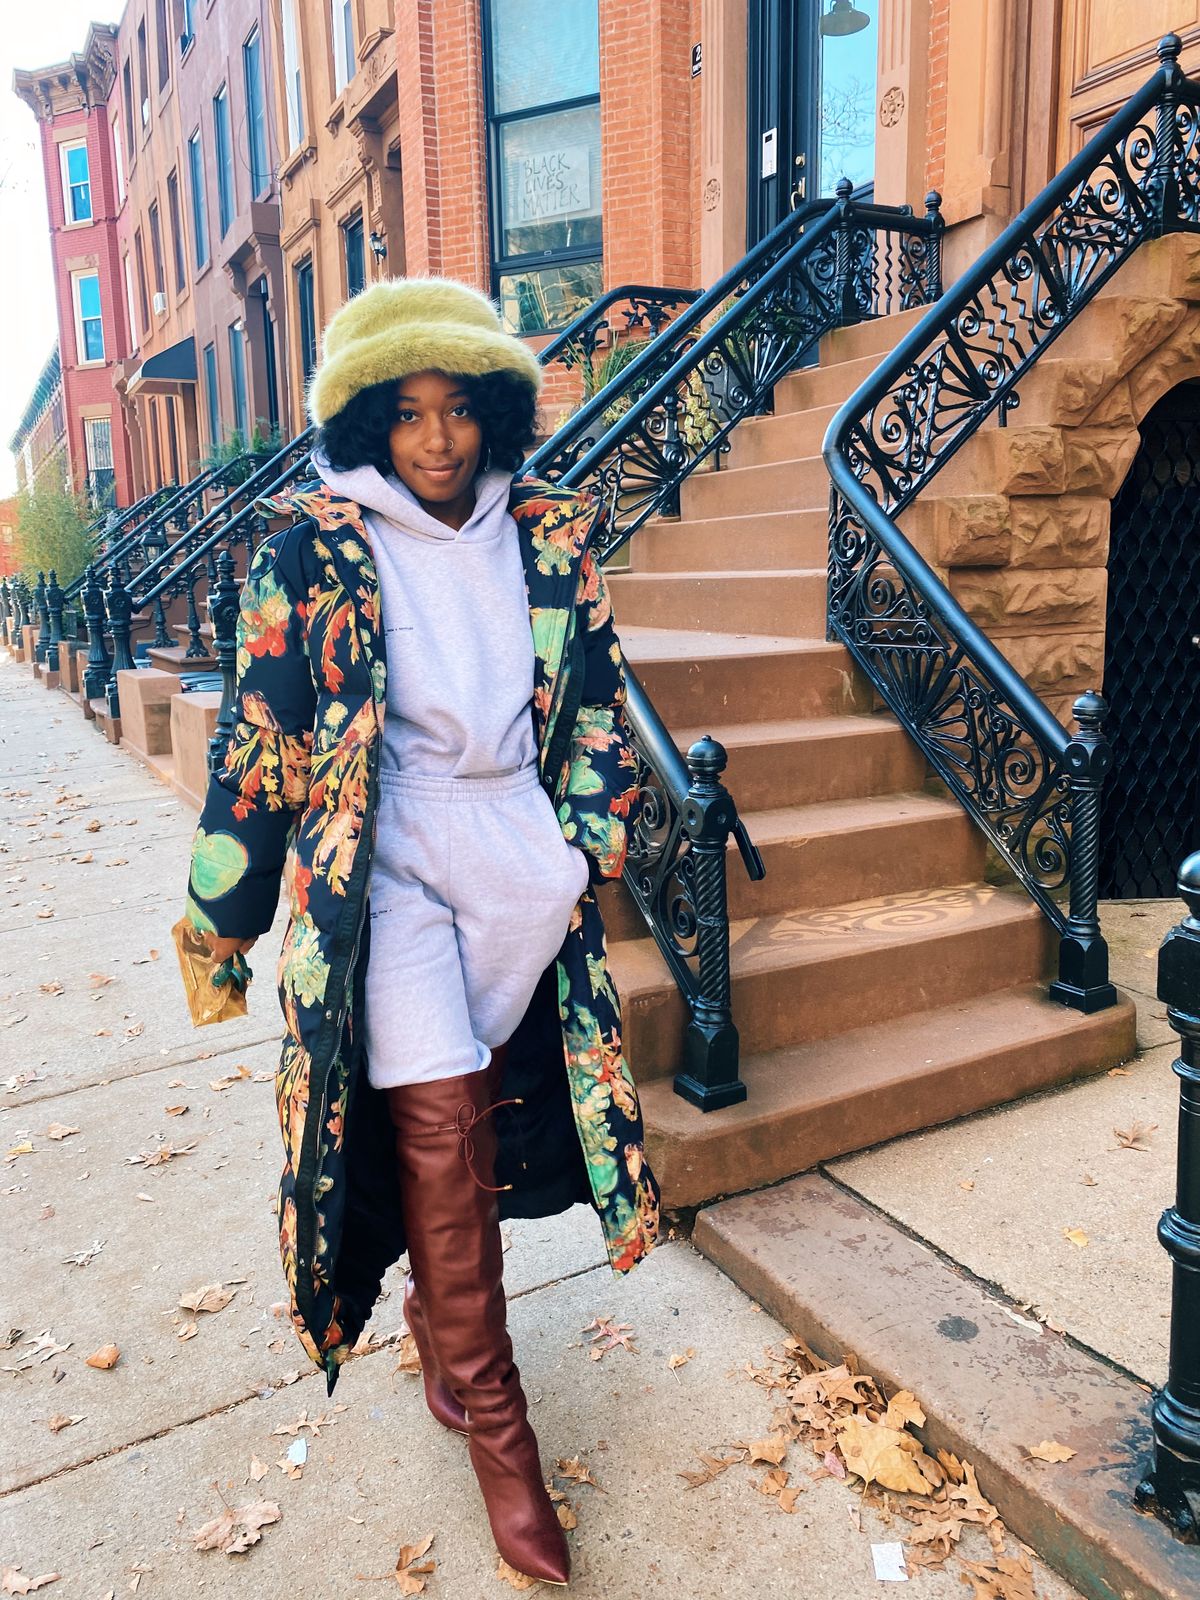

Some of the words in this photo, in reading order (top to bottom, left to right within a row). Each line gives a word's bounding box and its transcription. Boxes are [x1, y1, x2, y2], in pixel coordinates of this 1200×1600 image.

[523, 153, 570, 177] BLACK
[525, 170, 564, 194] LIVES
[523, 184, 580, 218] MATTER
